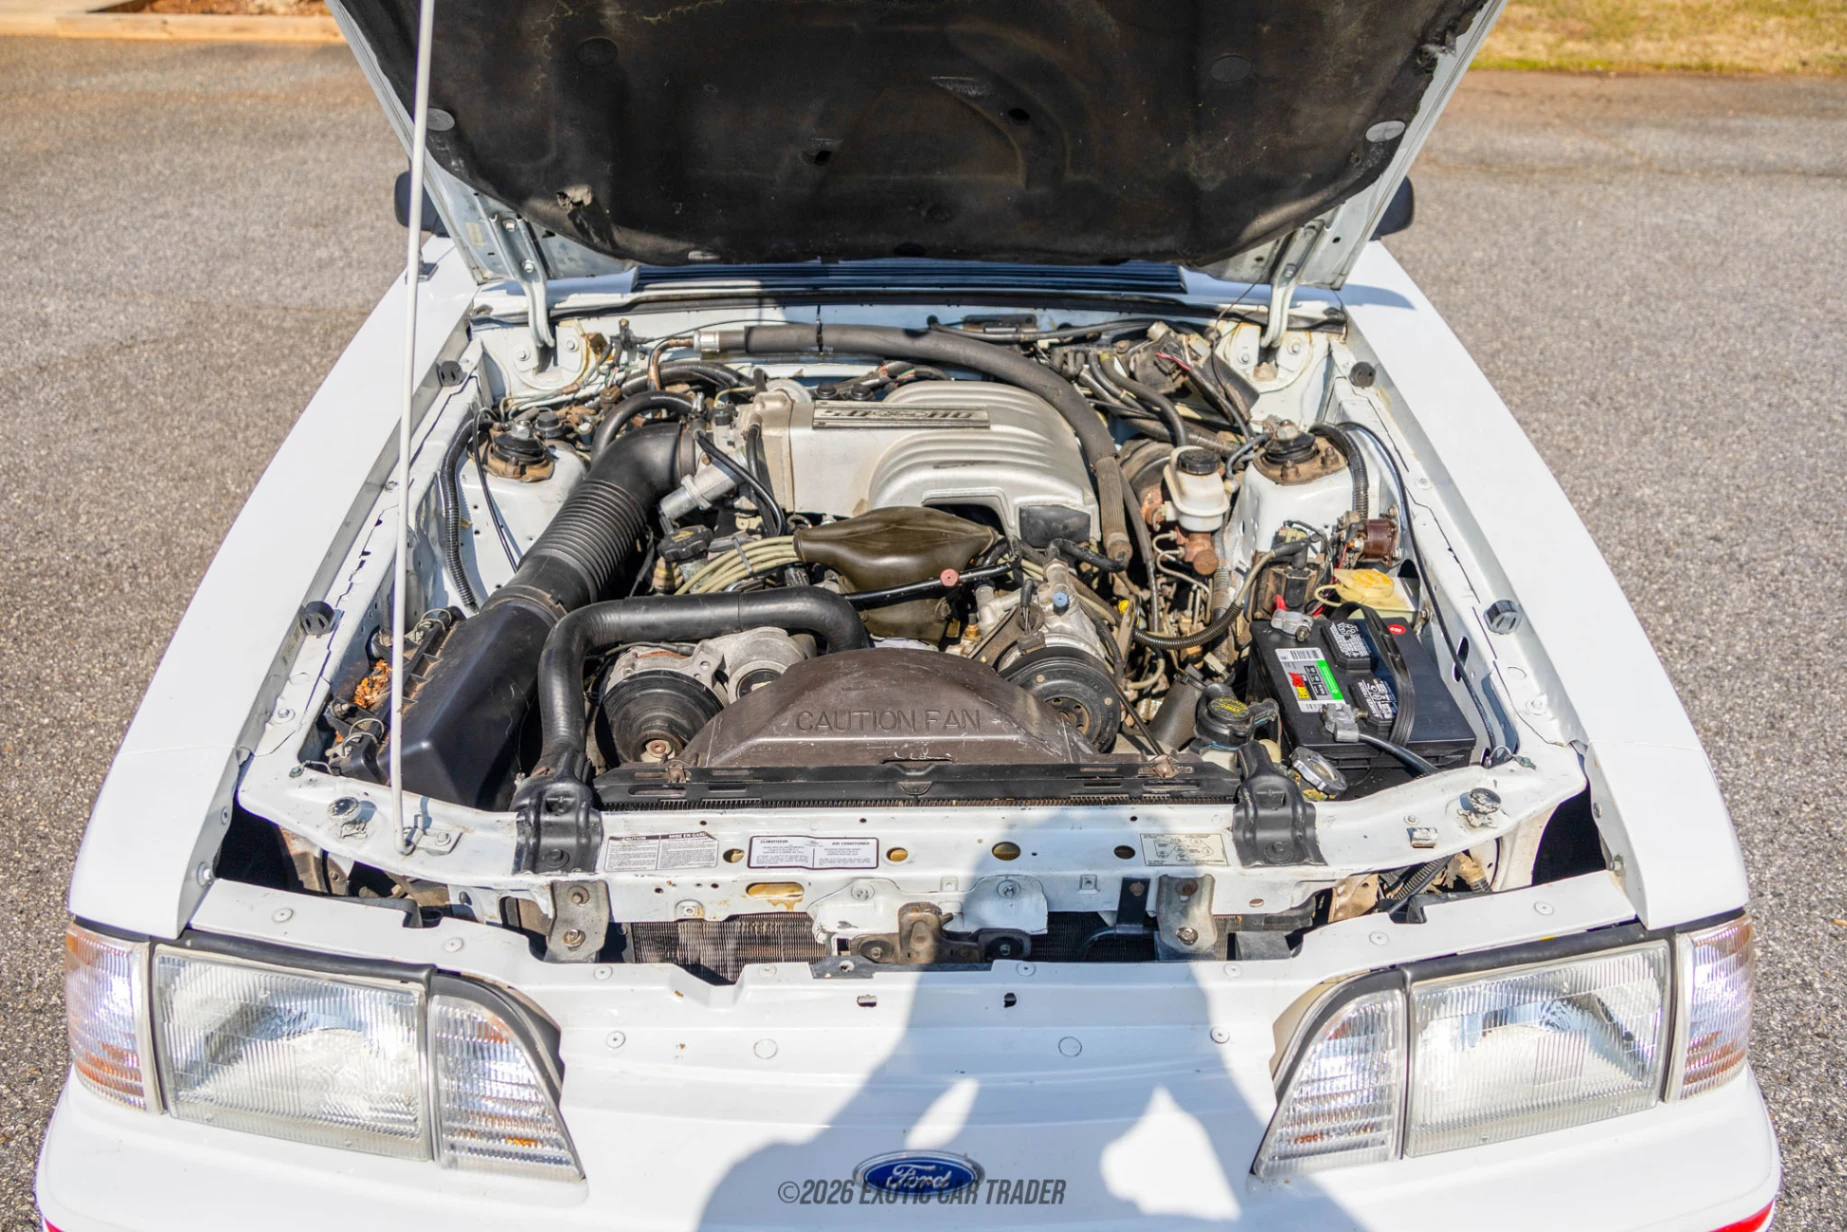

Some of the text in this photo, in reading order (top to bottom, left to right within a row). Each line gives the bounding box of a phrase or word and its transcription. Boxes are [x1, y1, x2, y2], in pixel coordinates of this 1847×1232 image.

[795, 708, 981, 732] CAUTION FAN
[885, 1163, 953, 1190] Ford
